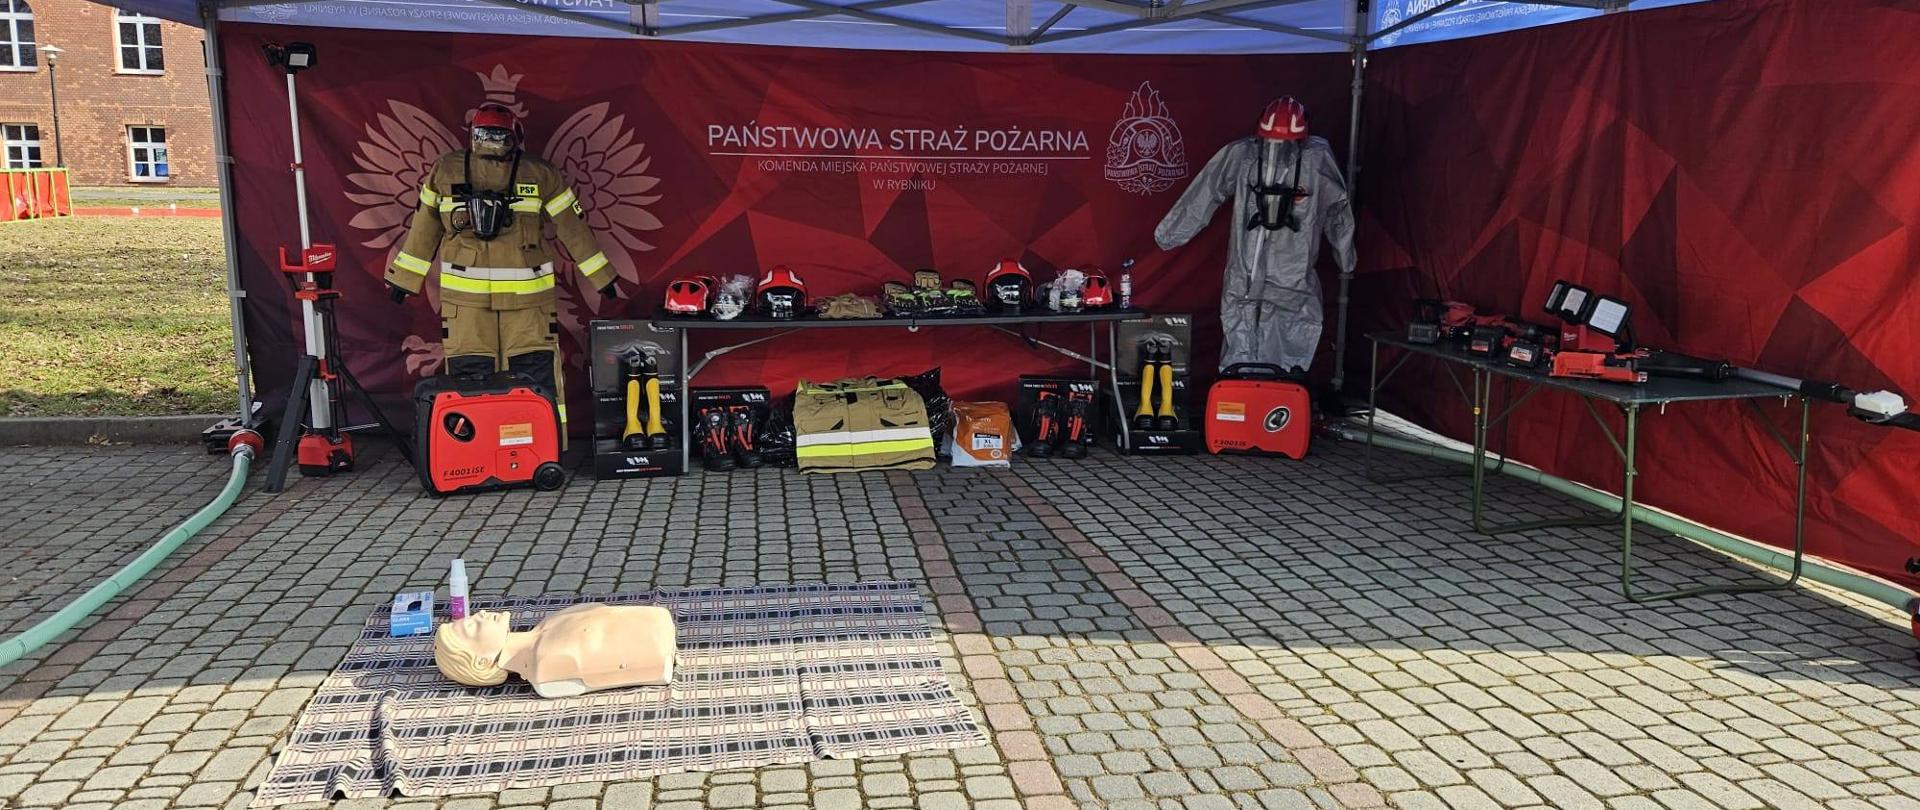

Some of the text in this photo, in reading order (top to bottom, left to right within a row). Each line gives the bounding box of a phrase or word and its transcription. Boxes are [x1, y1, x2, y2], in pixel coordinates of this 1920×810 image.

[708, 120, 1089, 151] PAŃSTWOWA STRAŻ POŻARNA
[758, 159, 1049, 176] KOMENDA MIEJSKA PAŃSTWOWEJ STRAŻY POŻARNEJ
[520, 186, 536, 194] PSP
[873, 179, 936, 191] W RYBNIKU
